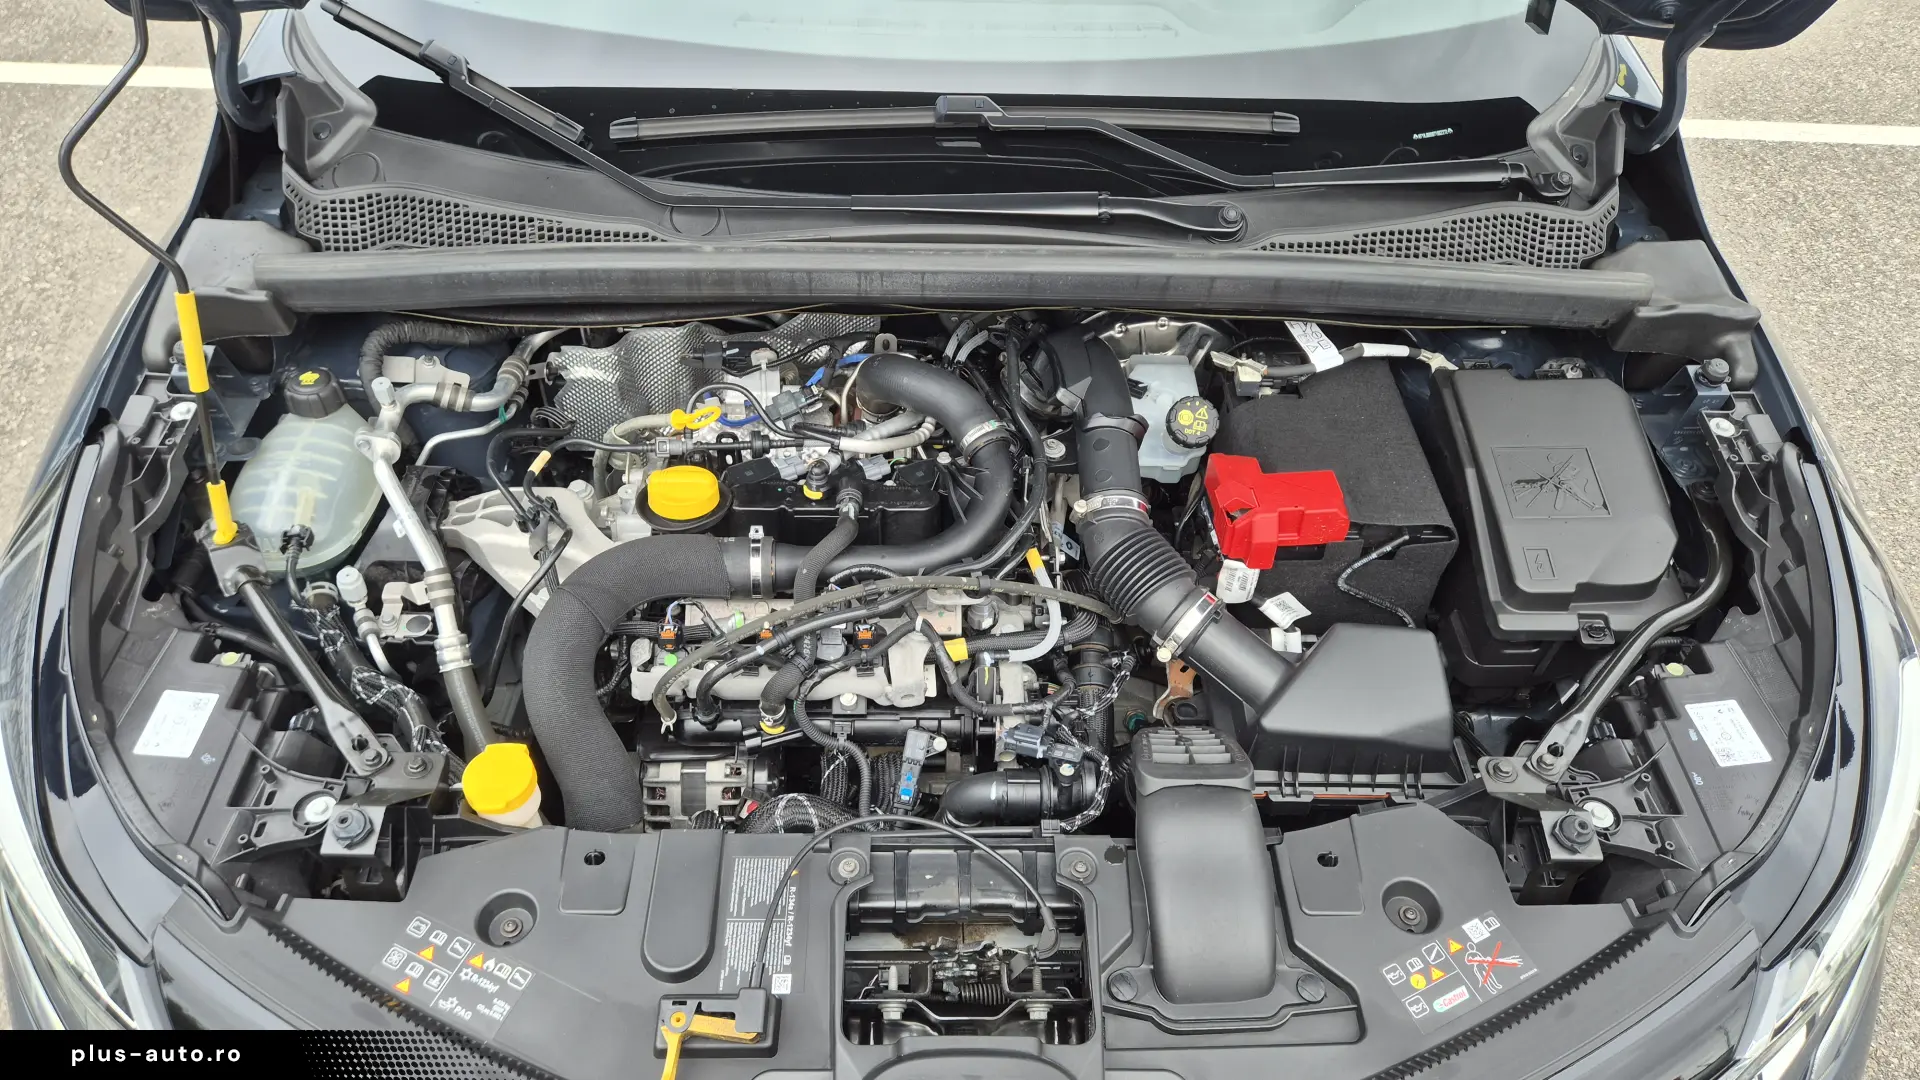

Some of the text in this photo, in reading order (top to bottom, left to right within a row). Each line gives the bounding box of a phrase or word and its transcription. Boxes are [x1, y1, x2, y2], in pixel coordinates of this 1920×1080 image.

[789, 886, 797, 910] R-134a
[784, 915, 794, 947] R-1234yf
[470, 973, 500, 993] R-1234yf
[1442, 988, 1467, 1007] Castrol
[453, 1005, 473, 1021] PAG
